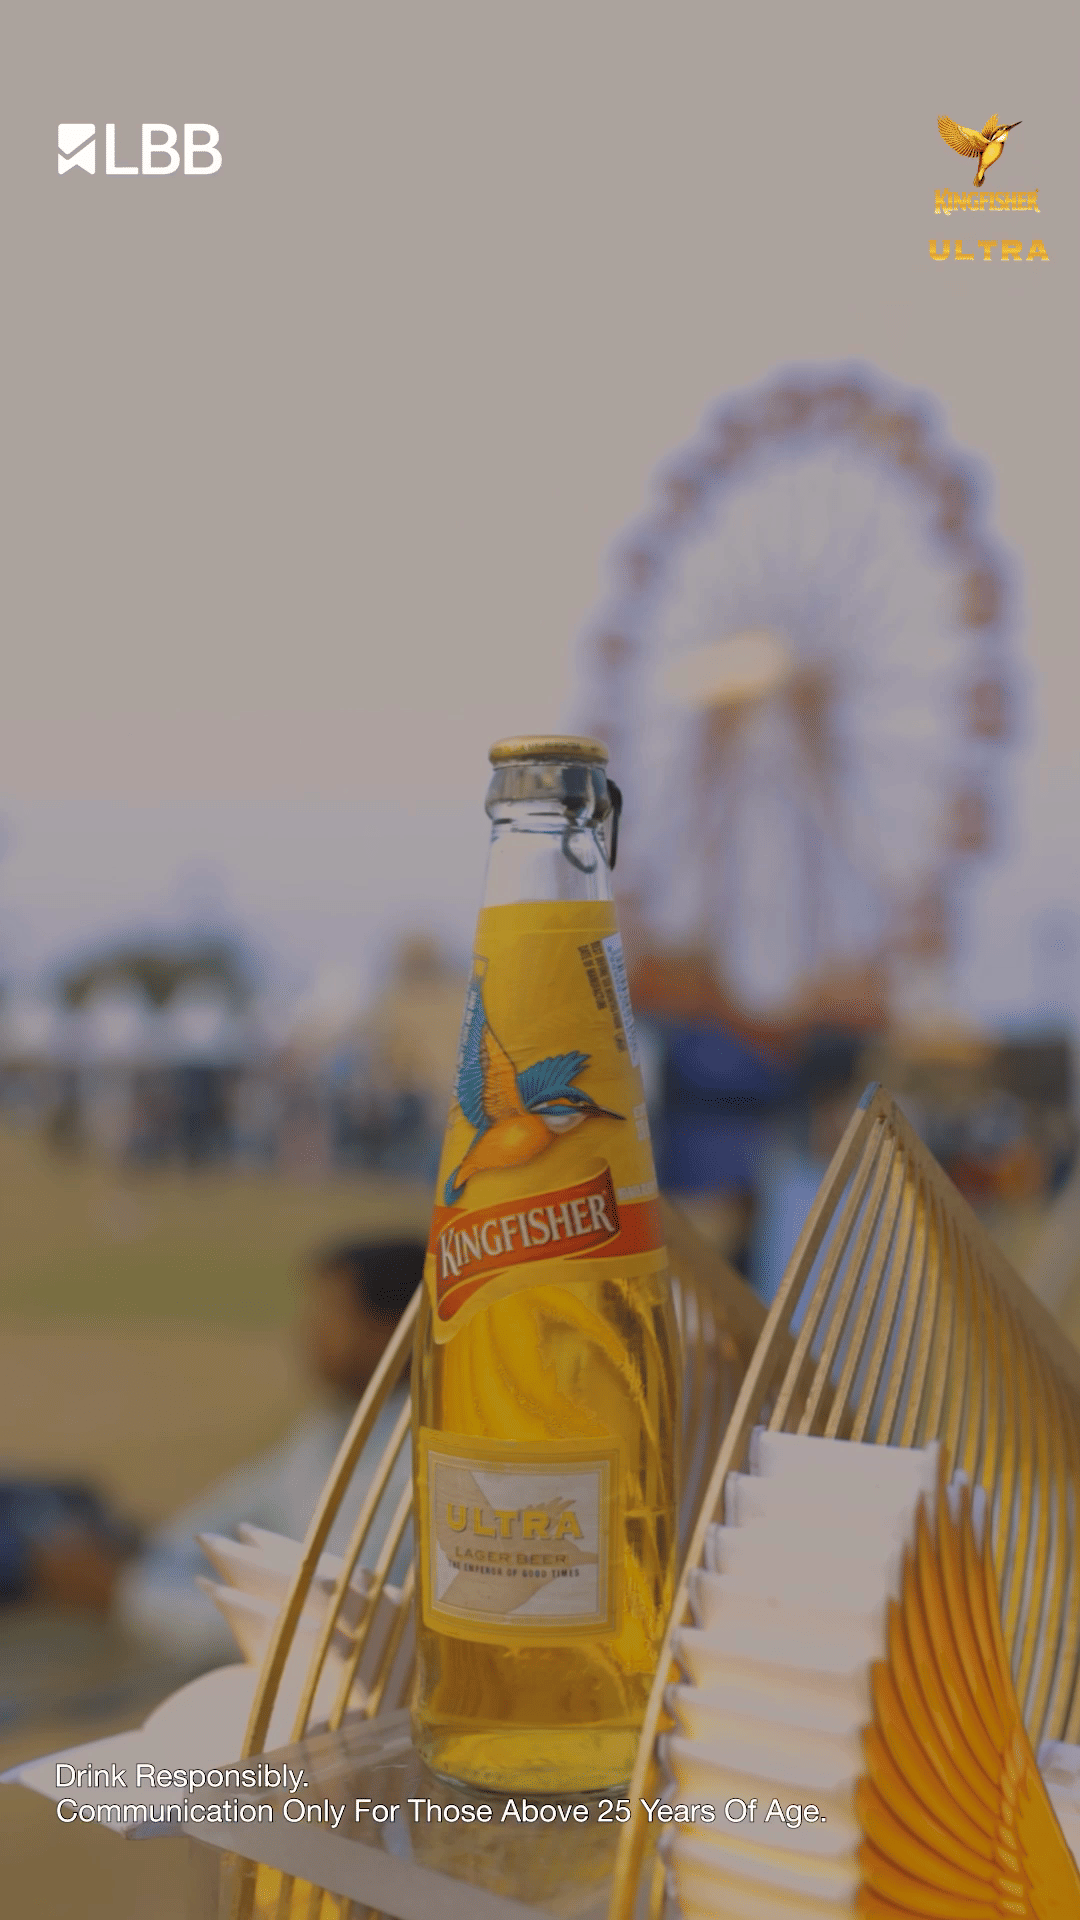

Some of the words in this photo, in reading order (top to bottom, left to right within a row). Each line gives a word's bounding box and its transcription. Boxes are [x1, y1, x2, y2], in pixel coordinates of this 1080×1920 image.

[440, 1194, 616, 1280] KINGFISHER
[446, 1502, 583, 1540] ULTRA
[454, 1546, 511, 1564] LAGER
[516, 1553, 568, 1566] BEER
[506, 1567, 518, 1577] OF
[521, 1568, 548, 1579] GOOD
[551, 1568, 580, 1579] TIMES
